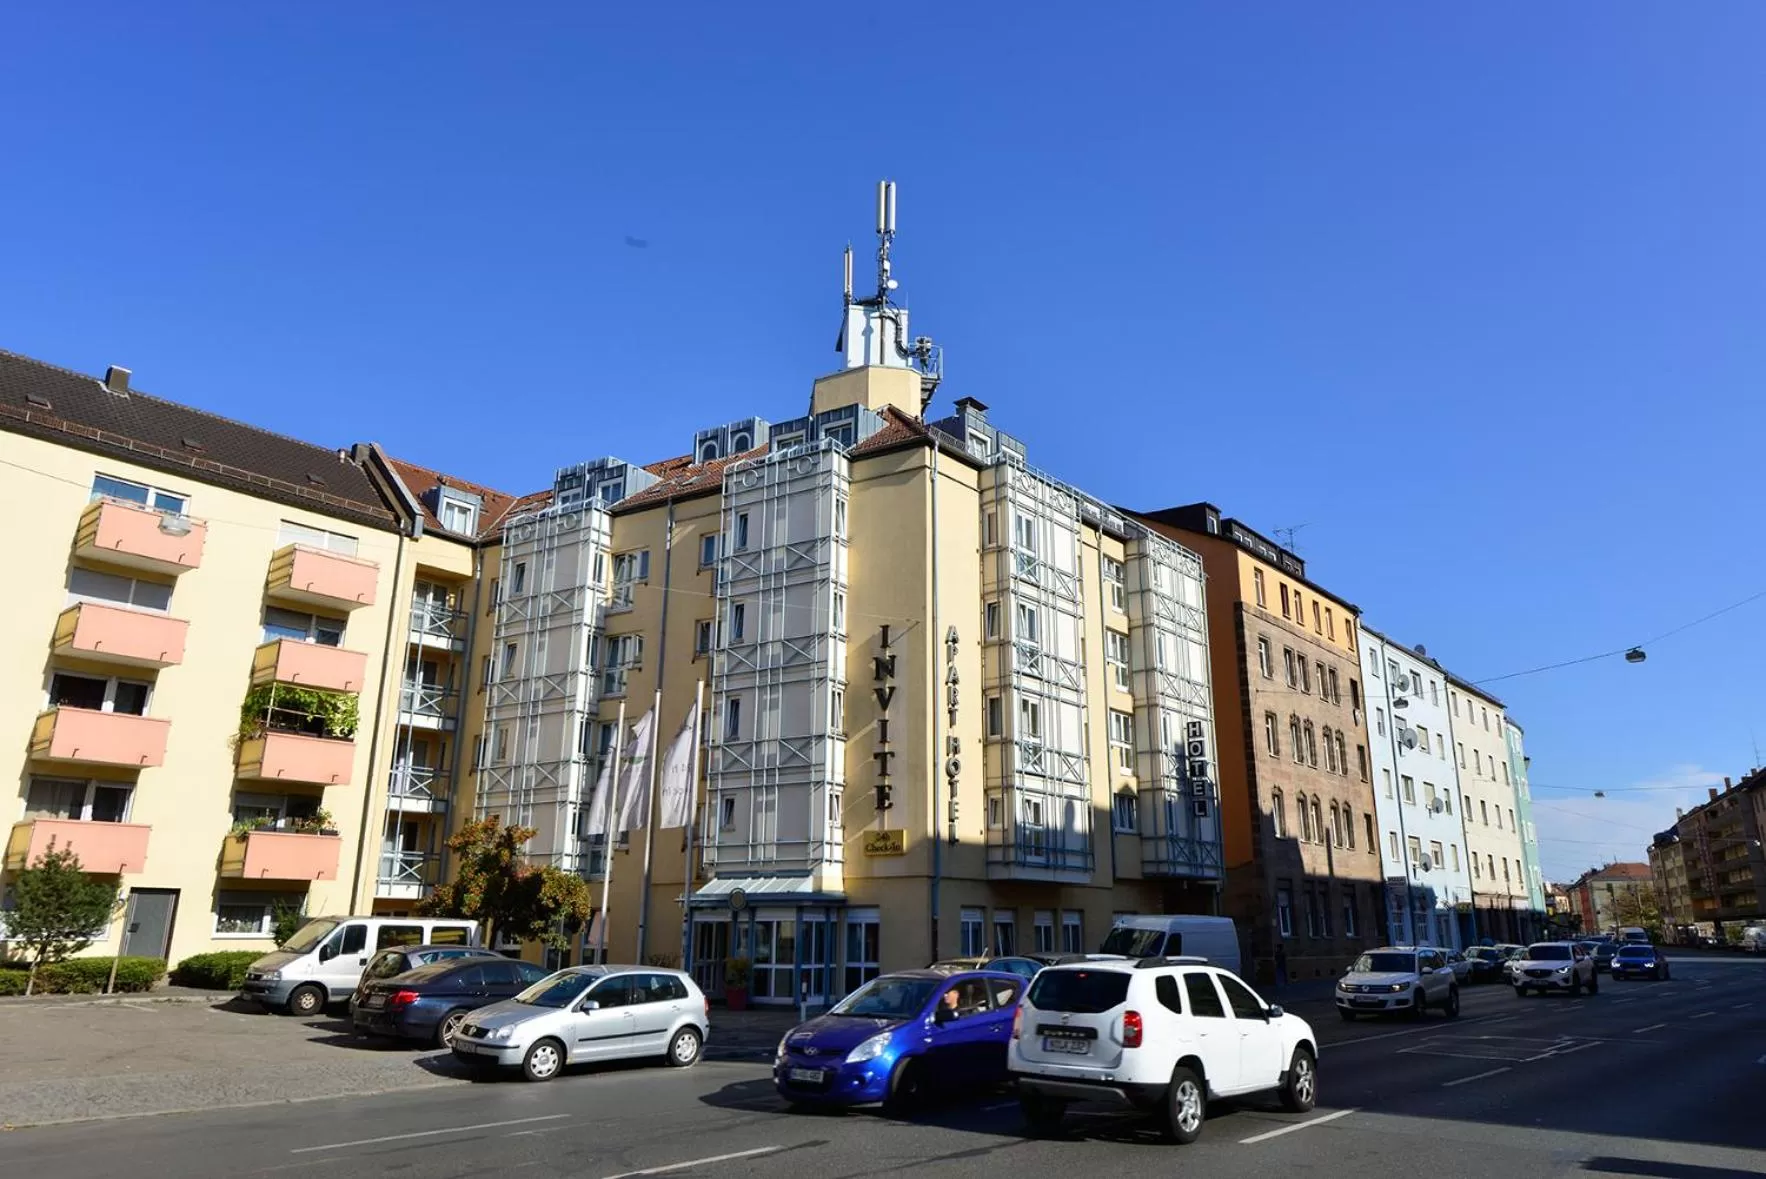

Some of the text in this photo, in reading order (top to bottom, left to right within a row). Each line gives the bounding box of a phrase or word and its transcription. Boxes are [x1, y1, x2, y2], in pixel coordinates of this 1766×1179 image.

[873, 624, 897, 811] INVITE
[1188, 722, 1206, 816] HOTEL
[945, 735, 961, 845] HOTEL
